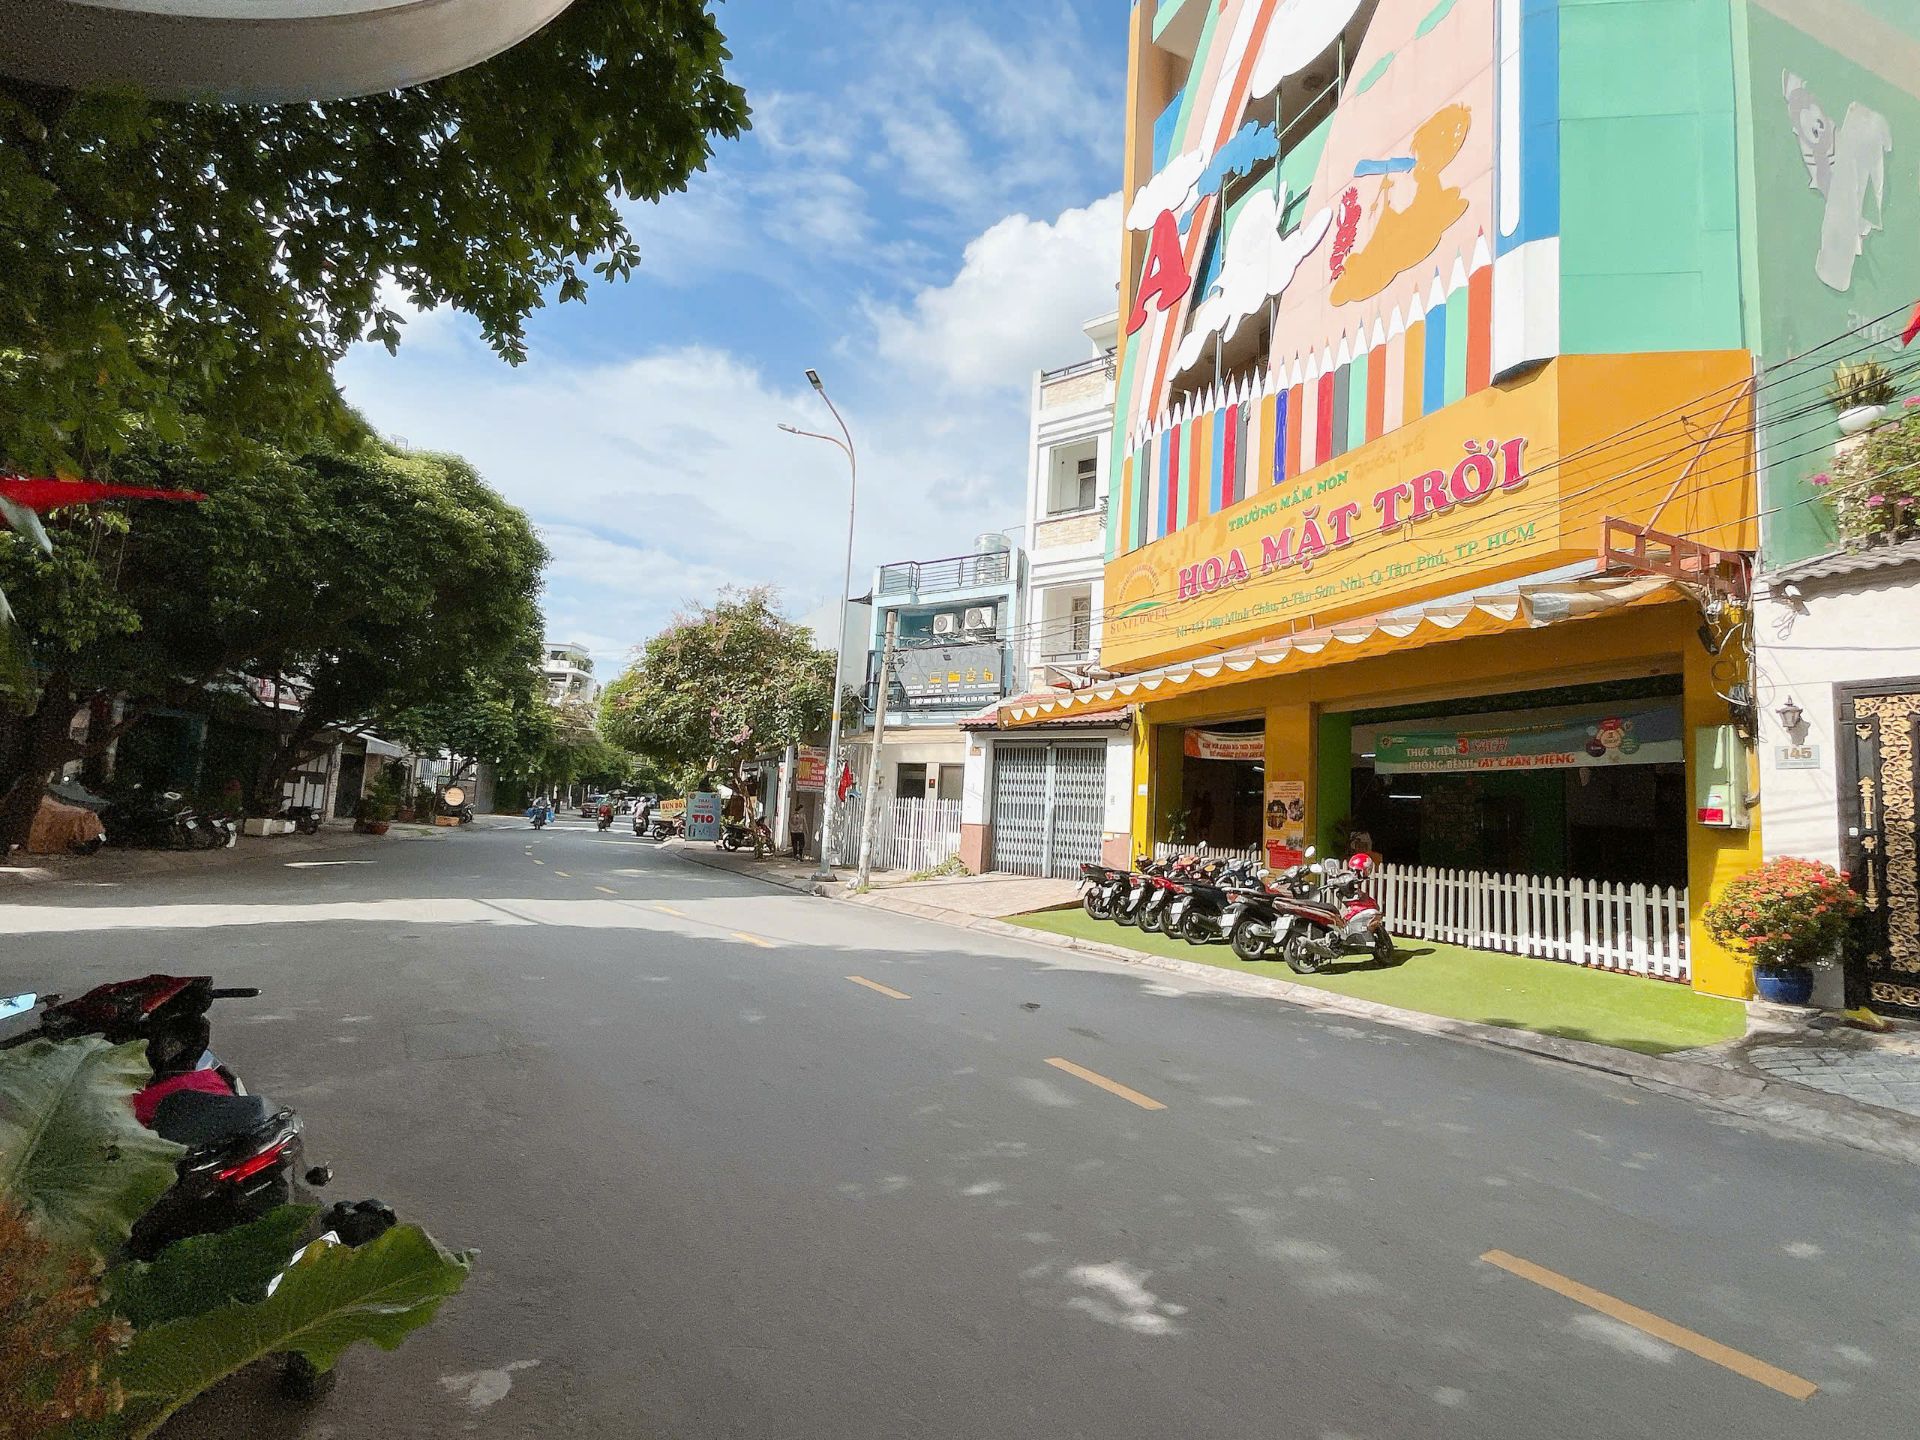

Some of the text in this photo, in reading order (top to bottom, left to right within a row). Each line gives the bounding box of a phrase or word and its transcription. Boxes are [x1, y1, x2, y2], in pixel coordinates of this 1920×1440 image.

[1229, 502, 1277, 531] TRƯỜNG
[1317, 470, 1349, 495] NON
[1178, 549, 1251, 602] HOA
[1260, 503, 1360, 574] MẶT
[1373, 437, 1528, 535] TRỜI
[1487, 522, 1536, 551] HCM
[1457, 737, 1470, 756] 3
[1781, 747, 1812, 759] 145
[692, 814, 714, 824] TIO
